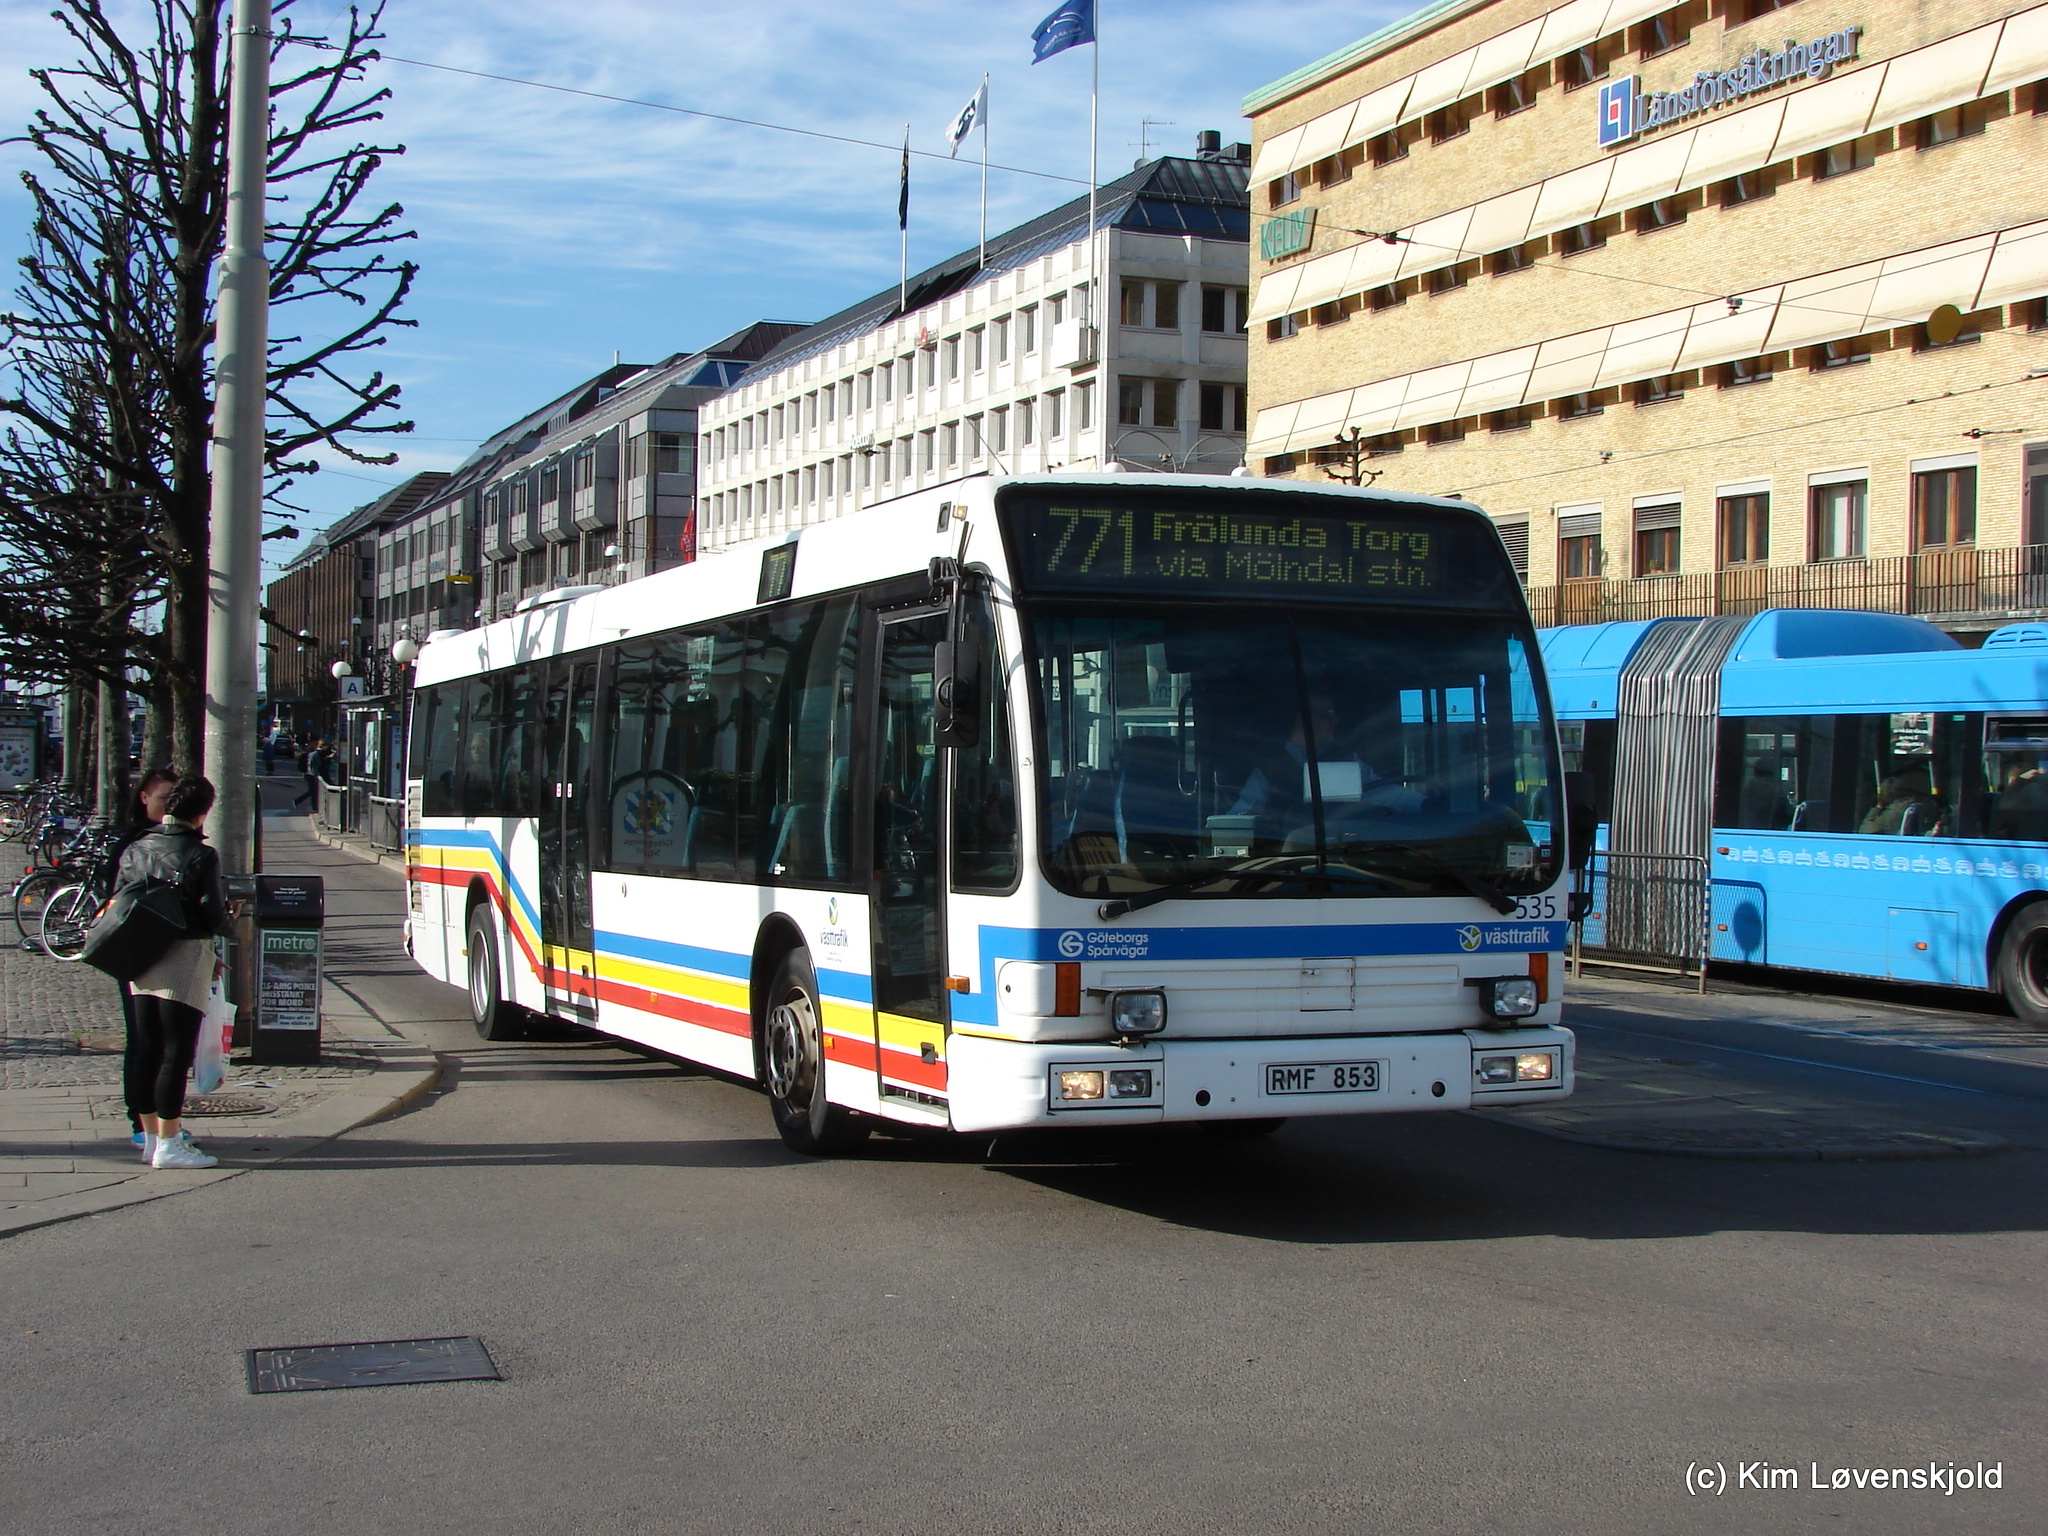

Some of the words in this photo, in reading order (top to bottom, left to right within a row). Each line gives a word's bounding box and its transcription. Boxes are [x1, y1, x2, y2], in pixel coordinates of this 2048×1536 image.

[1634, 25, 1858, 133] Länsförsäkringar
[1261, 206, 1308, 261] KELLY
[1048, 507, 1134, 576] 771
[1153, 511, 1327, 548] Frölunda
[1346, 521, 1429, 560] Torg
[1155, 549, 1209, 578] via
[1225, 551, 1353, 583] Mölndal
[1367, 558, 1432, 586] stn.
[347, 682, 358, 694] A
[1515, 895, 1556, 919] 535
[267, 935, 317, 950] metro
[1086, 931, 1149, 946] Göteborgs
[1485, 926, 1550, 945] västtrafik
[1087, 944, 1149, 958] Spårvägar
[1272, 1068, 1316, 1091] RMF
[1333, 1065, 1376, 1089] 853
